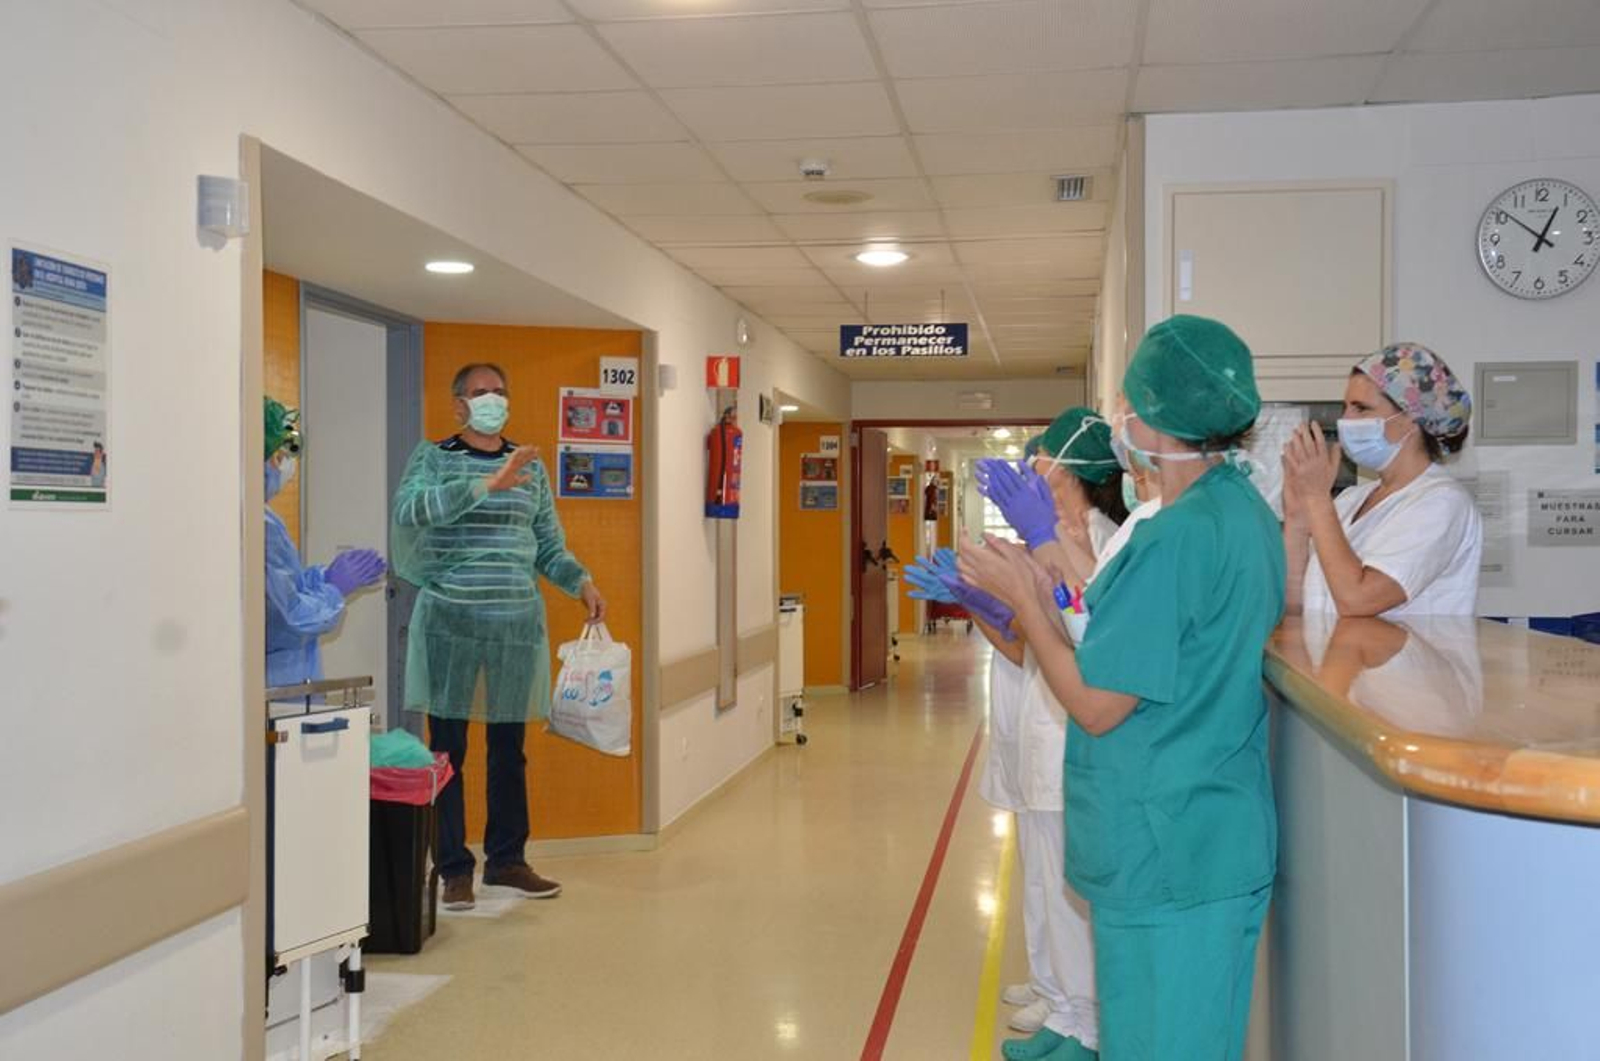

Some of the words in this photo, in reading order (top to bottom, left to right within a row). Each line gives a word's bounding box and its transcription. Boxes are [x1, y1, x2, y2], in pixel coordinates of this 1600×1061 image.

[1513, 194, 1525, 209] 11
[1535, 187, 1550, 202] 12
[1563, 193, 1568, 207] 1
[1495, 211, 1508, 225] 10
[1576, 209, 1588, 223] 2
[1489, 233, 1501, 246] 9
[1583, 230, 1594, 245] 3
[1496, 254, 1506, 269] 8
[1573, 253, 1585, 266] 4
[1511, 270, 1522, 288] 7
[1533, 277, 1545, 290] 6
[1558, 270, 1568, 284] 5
[862, 325, 946, 336] Prohibido
[853, 336, 955, 346] Permanecer
[845, 347, 867, 356] en
[872, 346, 896, 355] los
[900, 345, 963, 355] Pasillos
[603, 368, 635, 385] 1302
[1547, 527, 1593, 535] CURSAR
